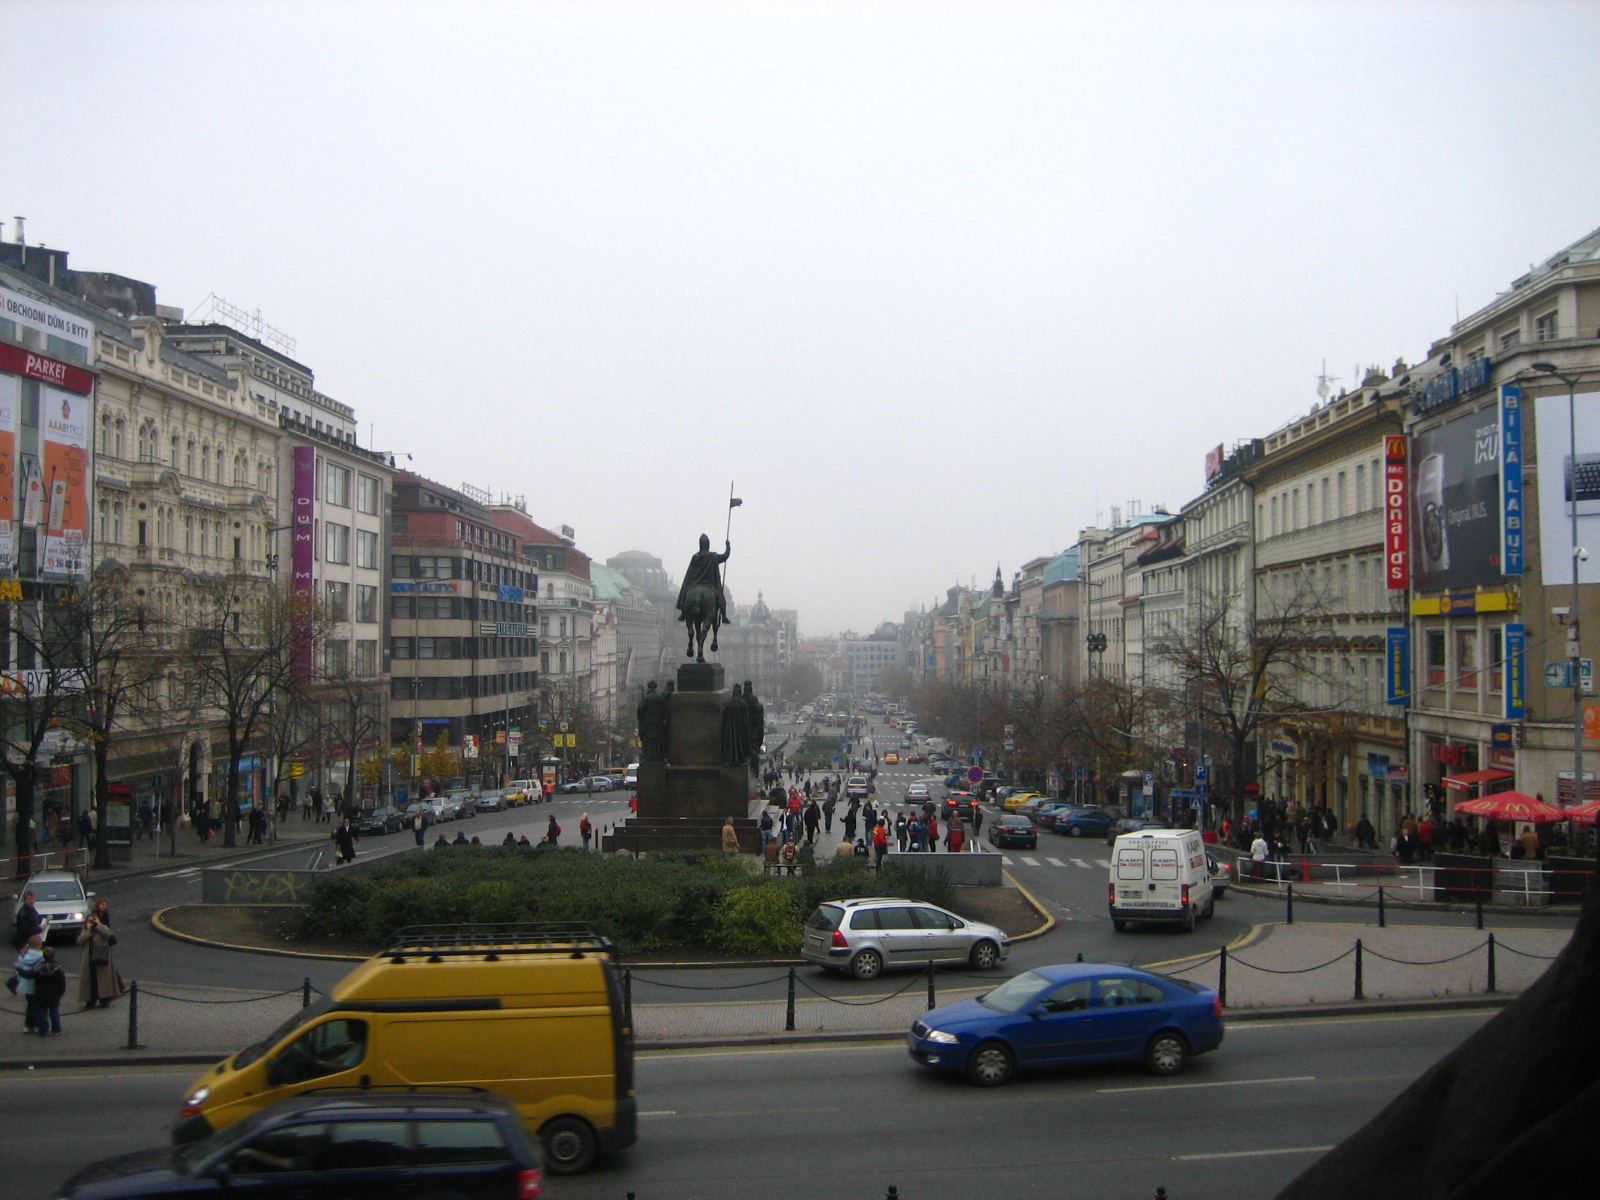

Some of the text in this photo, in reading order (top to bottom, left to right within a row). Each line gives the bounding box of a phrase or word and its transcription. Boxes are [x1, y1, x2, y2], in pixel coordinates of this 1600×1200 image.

[7, 300, 46, 324] OBCHODNÍ
[47, 314, 65, 331] DŮM
[66, 322, 71, 333] S
[72, 323, 89, 339] BYTY
[26, 354, 67, 379] PARKET
[1504, 396, 1520, 566] BÍLÁ LABUŤ
[1146, 774, 1152, 782] P
[1197, 765, 1204, 776] P
